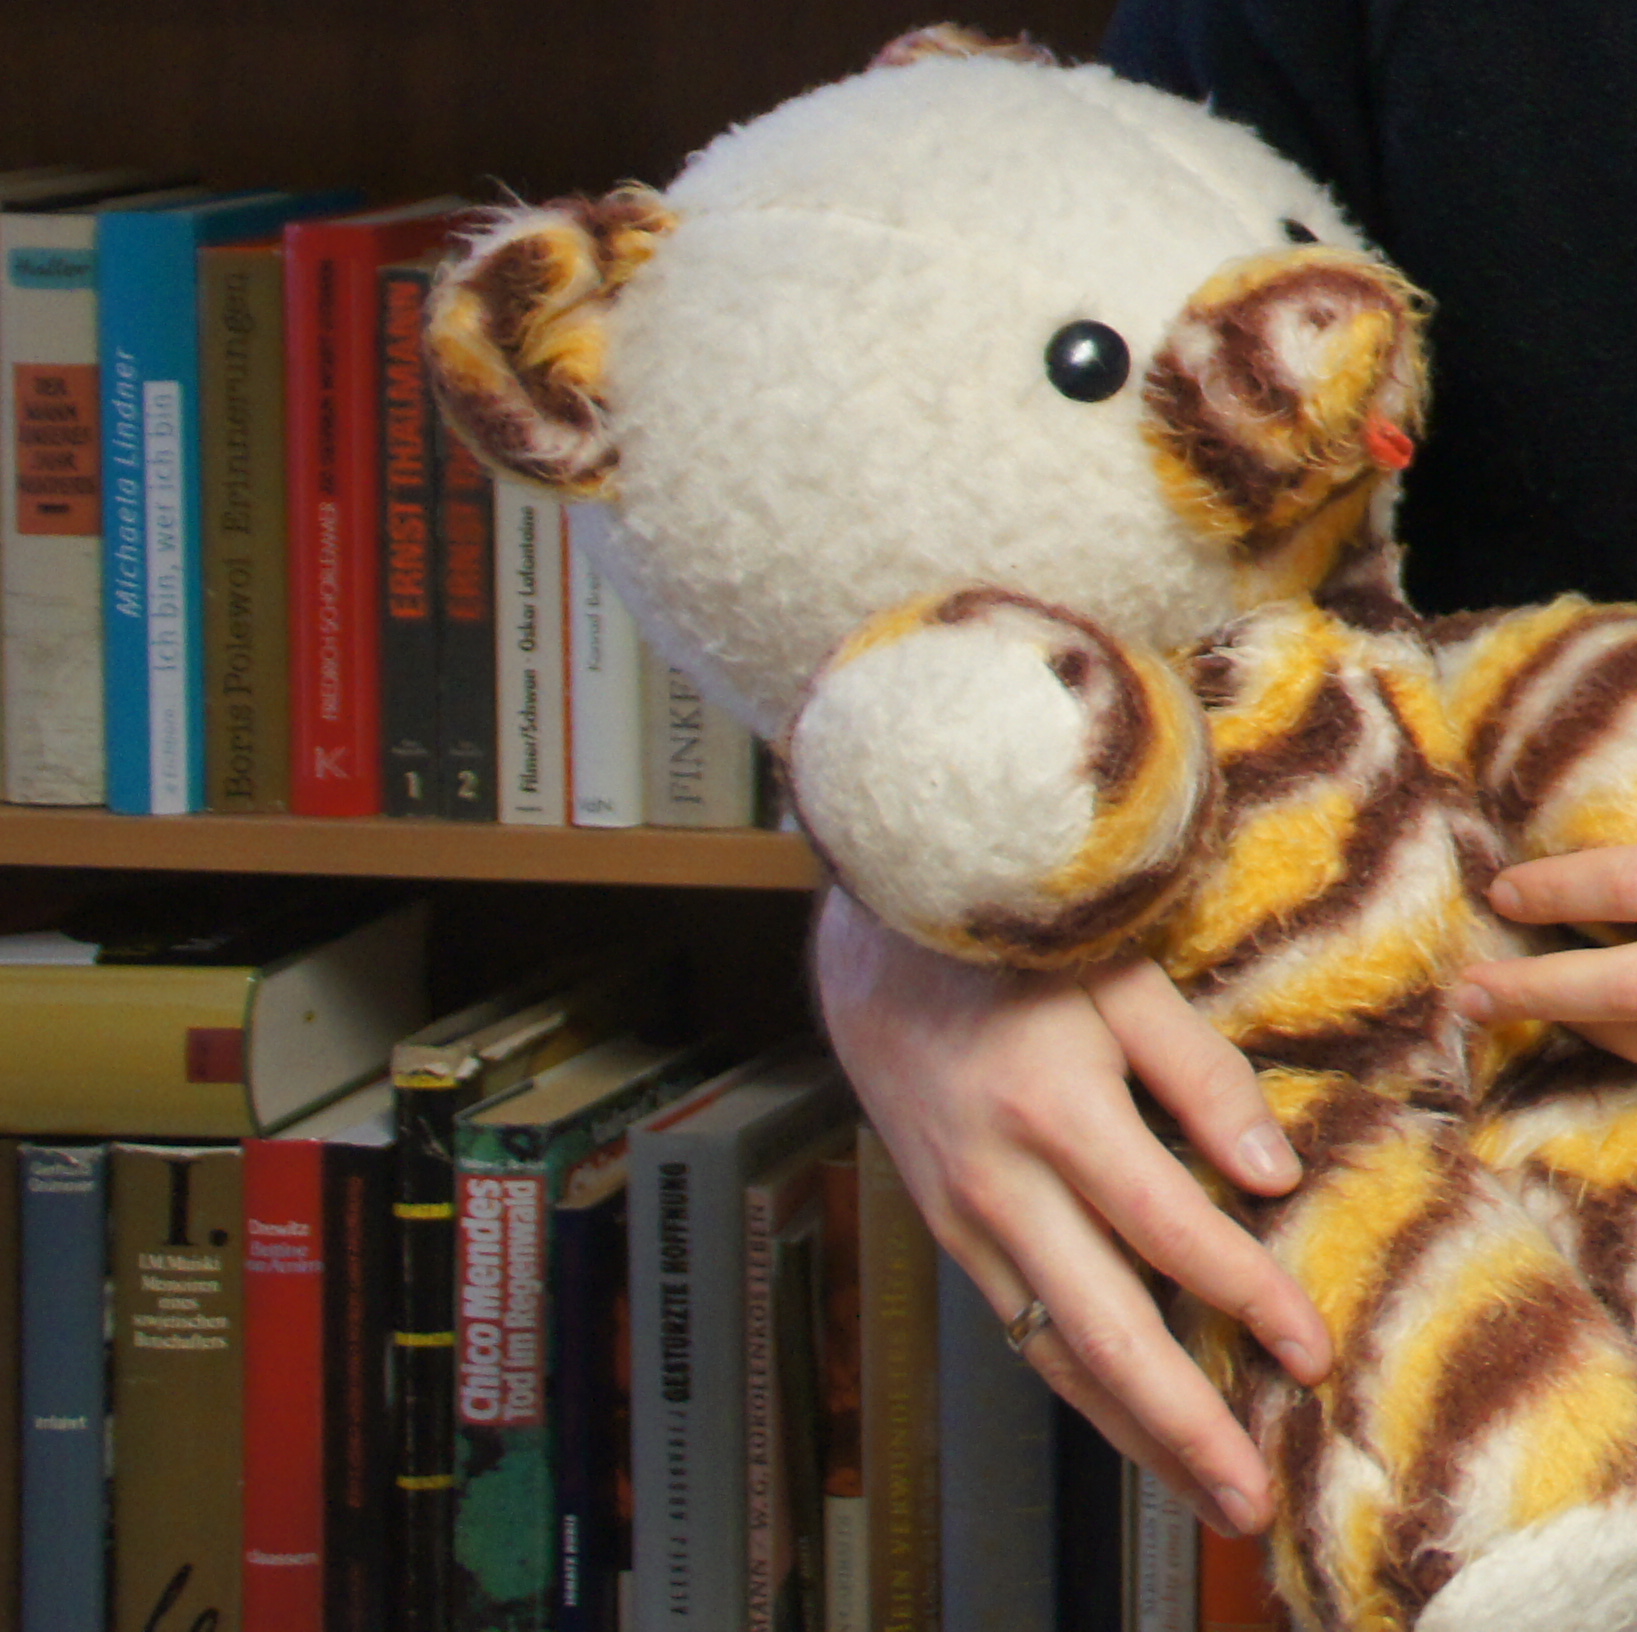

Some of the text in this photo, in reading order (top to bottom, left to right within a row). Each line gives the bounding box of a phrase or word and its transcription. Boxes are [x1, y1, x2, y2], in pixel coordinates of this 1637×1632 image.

[145, 393, 174, 440] bin
[108, 347, 143, 619] Michaela Lindner
[146, 449, 176, 491] ich
[152, 502, 175, 552] wer
[217, 271, 258, 802] Boris Polewoi Erinnerungen
[389, 502, 426, 620] ERNST
[514, 505, 538, 598] Lafontaine
[150, 629, 178, 671] Ich
[514, 604, 538, 654] Oskar
[456, 769, 480, 804] 2
[669, 666, 704, 805] FINKE
[657, 1162, 690, 1276] HOFFNUNG
[460, 1178, 503, 1422] Chico Mendes
[500, 1179, 543, 1421] Tod im Regenwald
